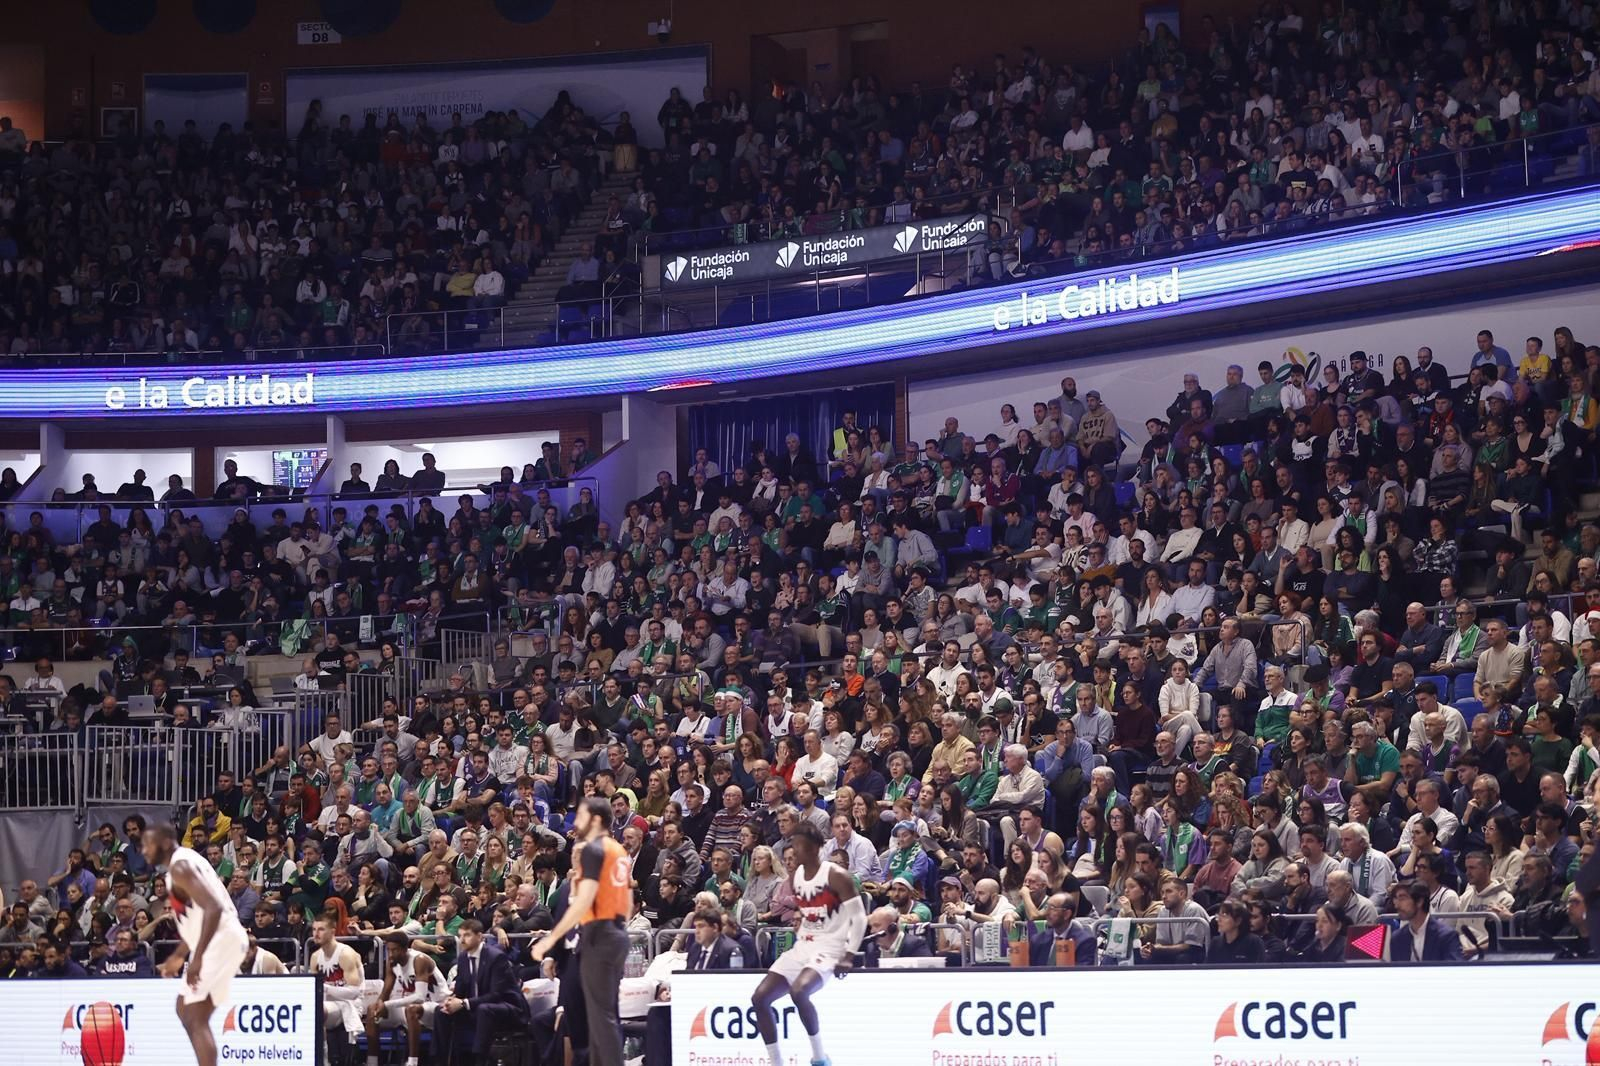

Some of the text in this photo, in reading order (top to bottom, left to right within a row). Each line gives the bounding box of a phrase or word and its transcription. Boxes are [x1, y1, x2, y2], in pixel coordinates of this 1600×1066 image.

[300, 23, 336, 31] SECTO
[312, 32, 329, 43] D8
[441, 103, 483, 116] CARPENA
[803, 235, 864, 253] Fundación
[691, 250, 749, 267] Fundación
[803, 250, 847, 266] Unicaja
[691, 265, 733, 280] Unicaja
[994, 267, 1179, 330] e la Calidad
[105, 373, 314, 409] e la Calidad
[238, 1004, 302, 1033] caser
[956, 1001, 1055, 1037] caser
[1241, 1001, 1356, 1039] caser
[222, 1044, 302, 1064] Grupo Helvetia
[932, 1048, 1006, 1066] Preparados
